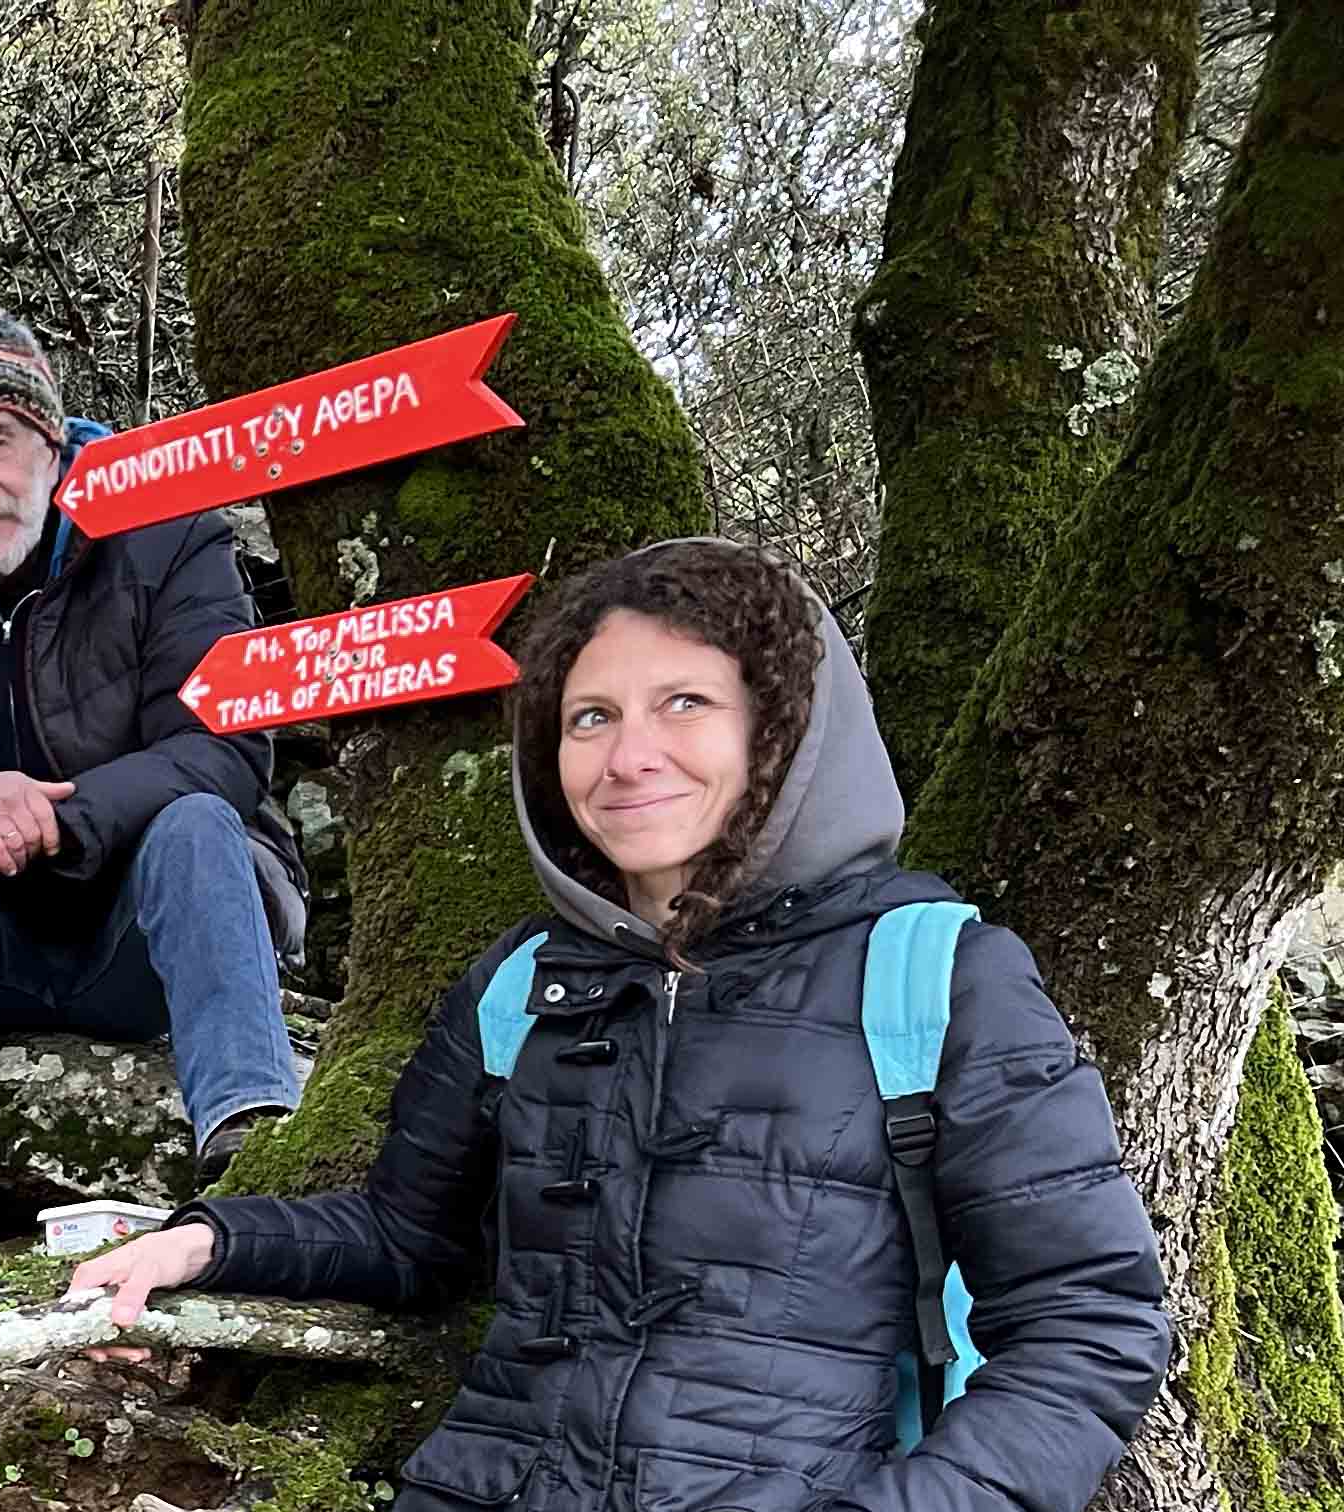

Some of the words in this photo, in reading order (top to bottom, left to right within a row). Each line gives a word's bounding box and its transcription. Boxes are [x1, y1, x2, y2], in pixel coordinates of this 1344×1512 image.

[86, 425, 234, 501] ΜΟΝΟΠΑΤΙ
[241, 403, 304, 446] ΤΟΥ
[312, 372, 420, 437] ΑΘΕΡΑ
[291, 681, 322, 710] OF
[327, 653, 457, 708] ATHERAS
[295, 656, 308, 681] 1
[314, 643, 387, 676] HOUR
